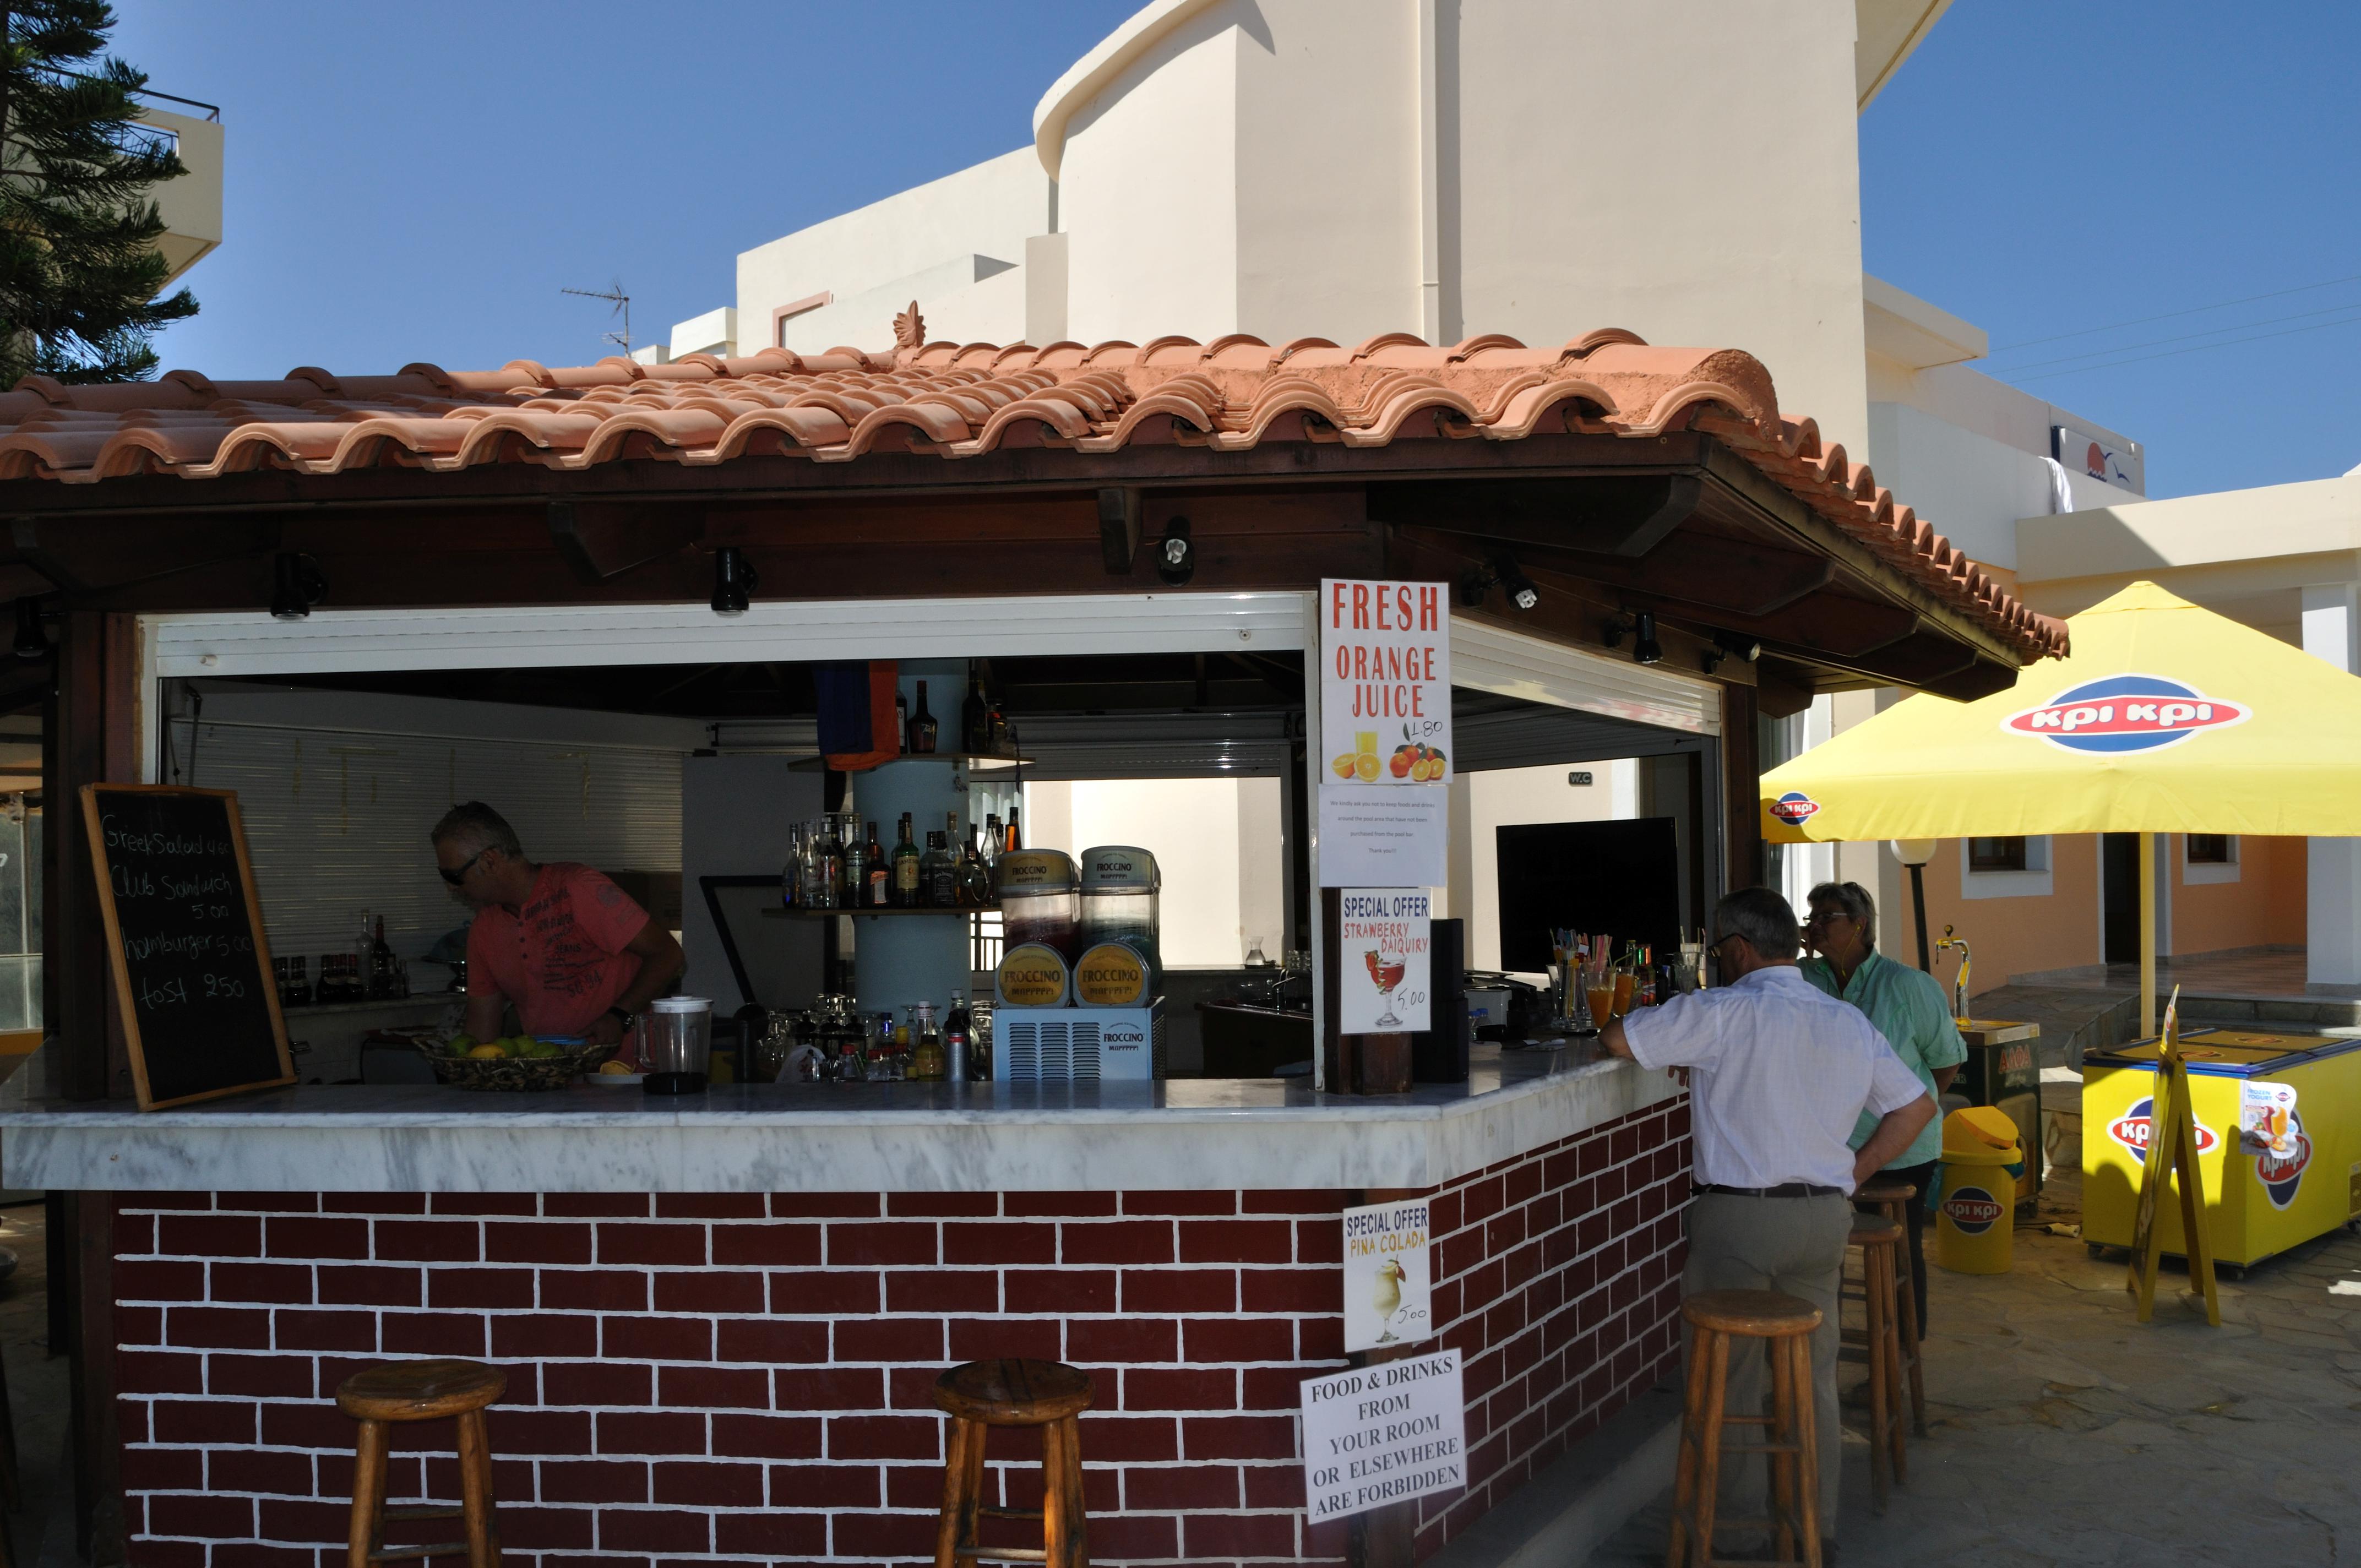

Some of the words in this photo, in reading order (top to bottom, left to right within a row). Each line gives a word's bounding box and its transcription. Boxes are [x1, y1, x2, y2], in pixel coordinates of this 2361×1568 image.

[1333, 583, 1438, 631] FRESH
[1336, 645, 1436, 681] ORANGE
[1352, 684, 1424, 717] JUICE
[1411, 721, 1443, 737] 1.80
[1570, 773, 1591, 784] W.C
[1013, 866, 1047, 875] FROCCINO
[1097, 863, 1131, 872] FROCCINO
[1344, 897, 1389, 918] SPECIAL
[1393, 897, 1428, 917] OFFER
[1344, 922, 1410, 939] STRAWBERRY
[1381, 938, 1428, 957] DAIQUIRY
[1004, 970, 1060, 983] FROCCINO
[1082, 970, 1138, 982] FROCCINO
[1104, 1033, 1143, 1042] FROCCINO
[1347, 1213, 1390, 1237] SPECIAL
[1395, 1207, 1427, 1230] OFFER
[1351, 1237, 1375, 1257] PINA
[1380, 1230, 1426, 1253] COLADA
[1312, 1371, 1362, 1402] FOOD
[1368, 1372, 1381, 1390] &
[1386, 1356, 1453, 1385] DRINKS
[1358, 1393, 1411, 1420] FROM
[1330, 1429, 1380, 1455] YOUR
[1386, 1414, 1440, 1442] ROOM
[1313, 1467, 1340, 1488] OR
[1350, 1437, 1459, 1479] ELSEWHERE
[1315, 1491, 1352, 1516] ARE
[1357, 1464, 1459, 1506] FORBIDDEN
